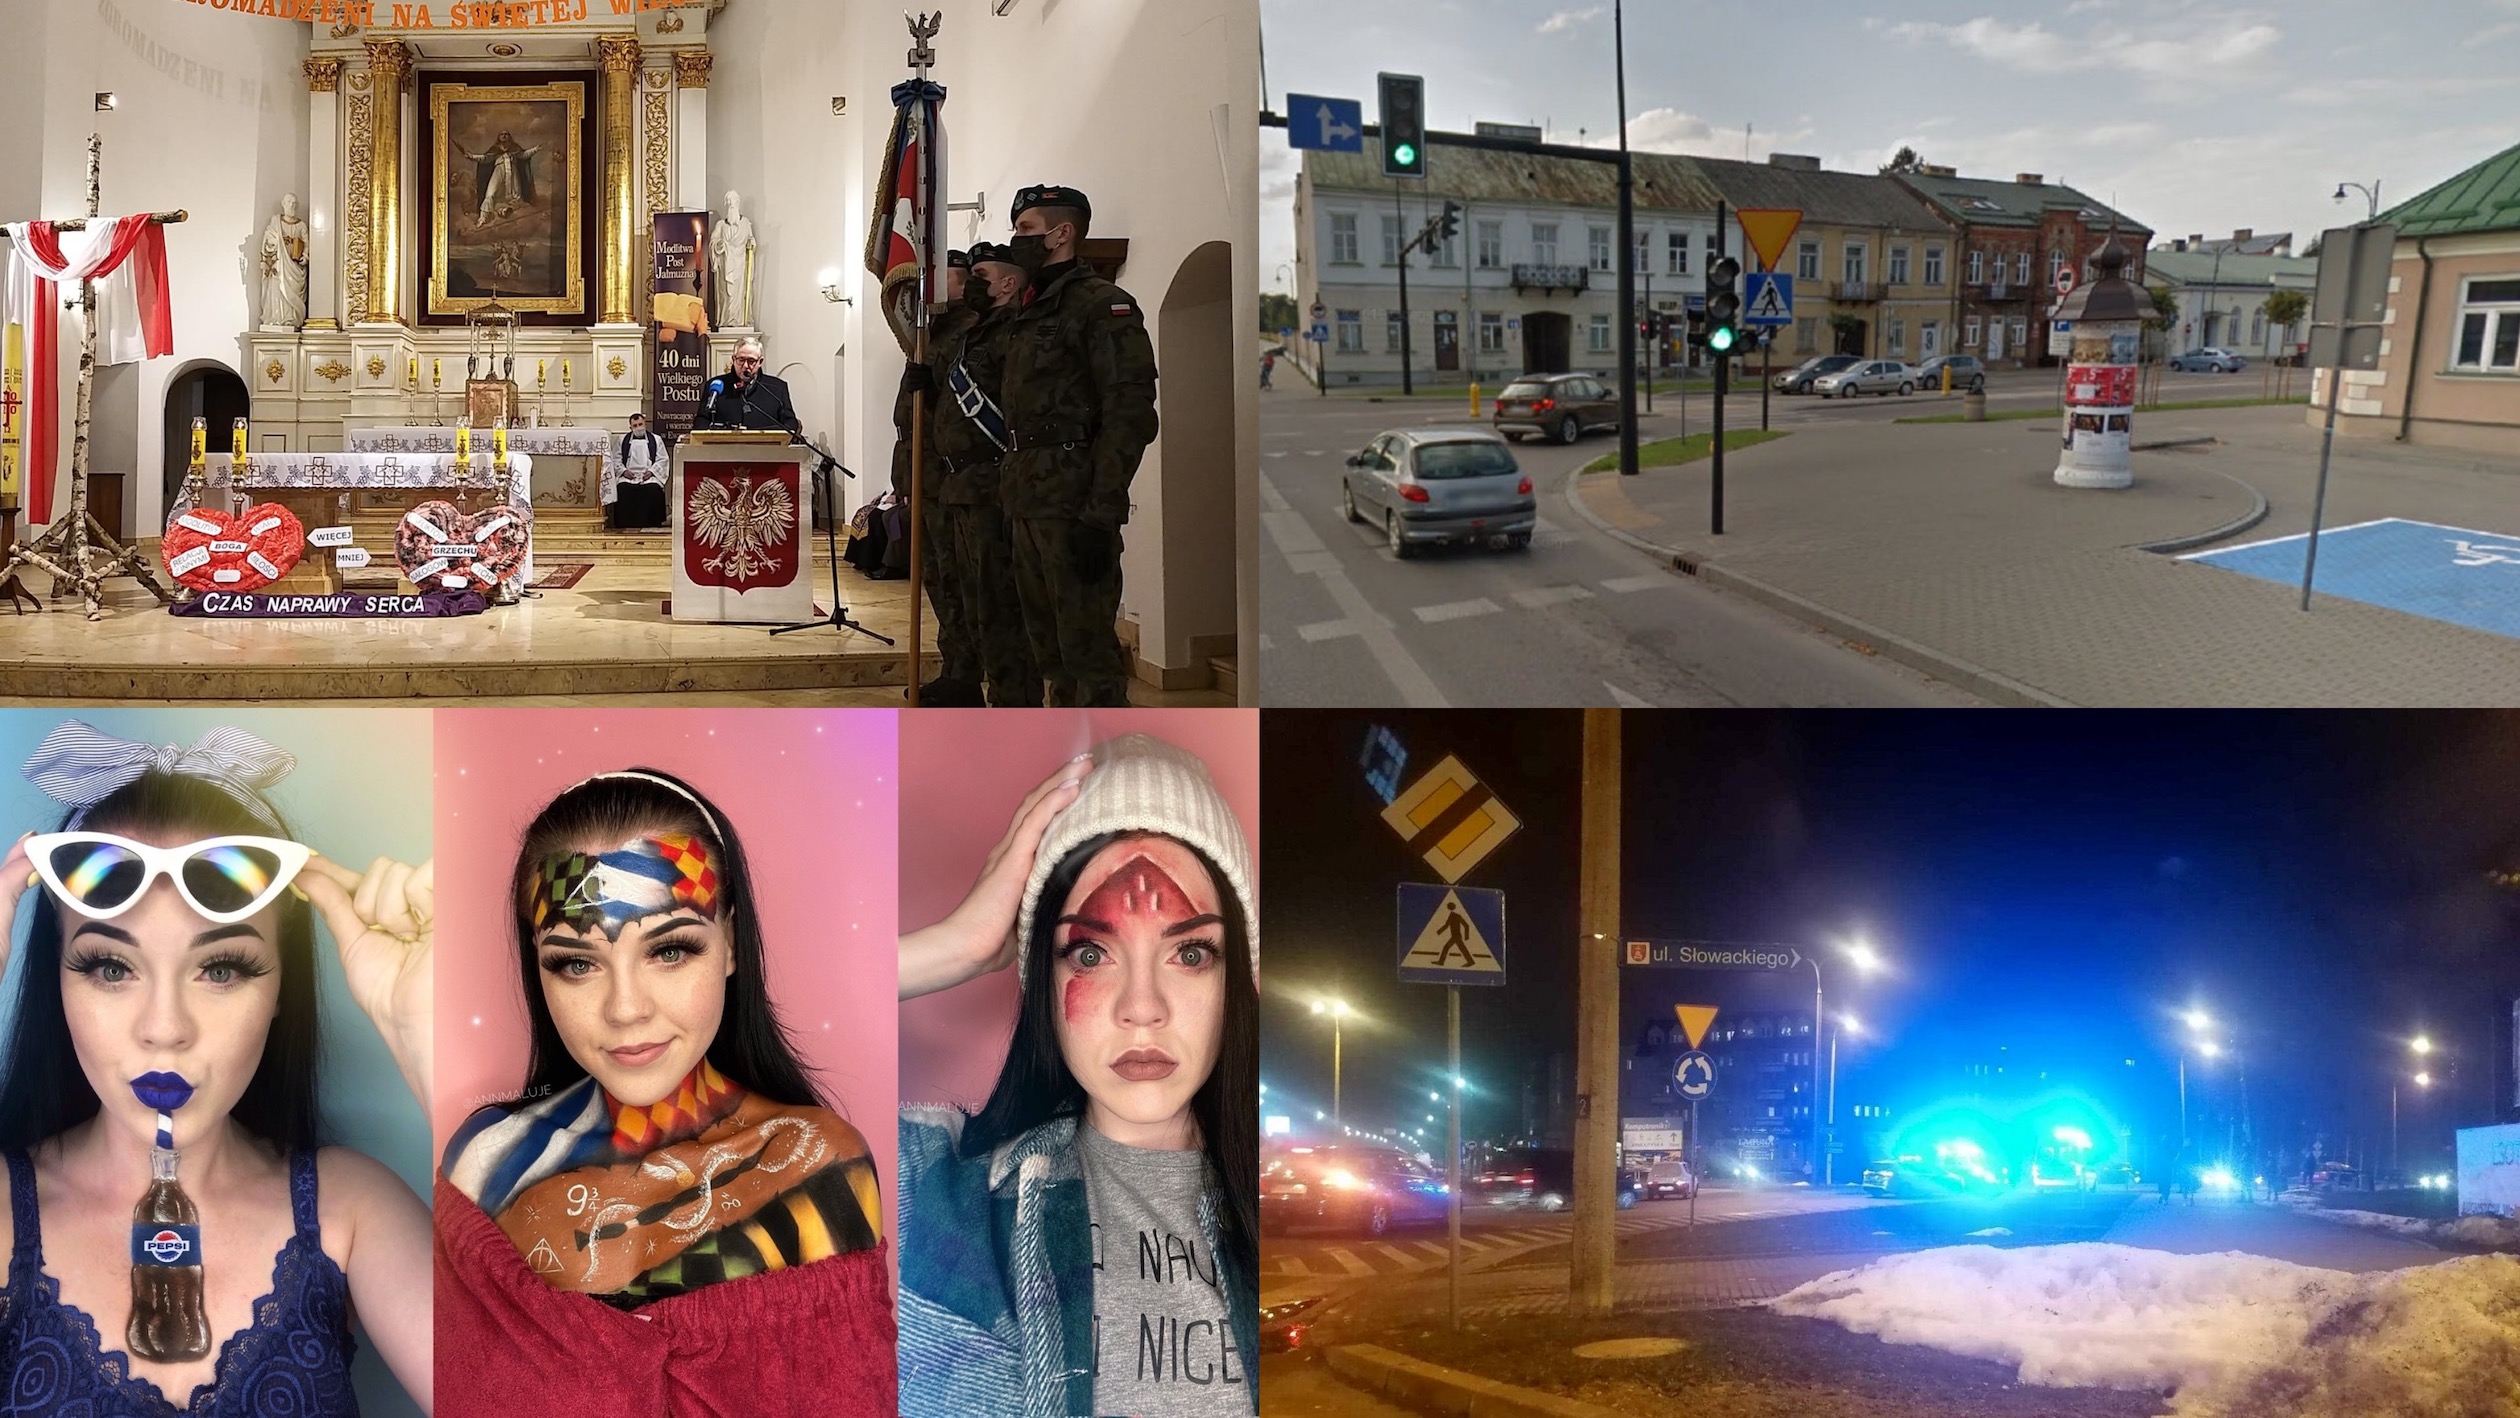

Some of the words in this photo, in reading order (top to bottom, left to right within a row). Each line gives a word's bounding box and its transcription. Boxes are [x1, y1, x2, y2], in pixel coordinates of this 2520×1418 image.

[392, 3, 433, 29] NA
[451, 0, 587, 29] ŚWIĘTEJ
[656, 241, 694, 253] Modlitwa
[665, 254, 685, 267] Post
[658, 349, 680, 368] 40
[681, 354, 700, 368] dni
[657, 372, 704, 387] Wielkiego
[662, 385, 701, 402] Postu
[316, 531, 351, 542] WIĘCEJ
[214, 542, 243, 550] BOGA
[433, 547, 477, 555] GRZECHU
[172, 548, 205, 567] RELACJI
[337, 553, 364, 562] MNIEJ
[202, 592, 253, 613] CZAS
[267, 596, 351, 613] NAPRAWY
[365, 596, 425, 614] SERCA
[1653, 946, 1673, 962] ul.
[1679, 946, 1789, 969] Słowackiego
[148, 1242, 186, 1250] PEPSI
[1138, 1313, 1242, 1385] NICE
